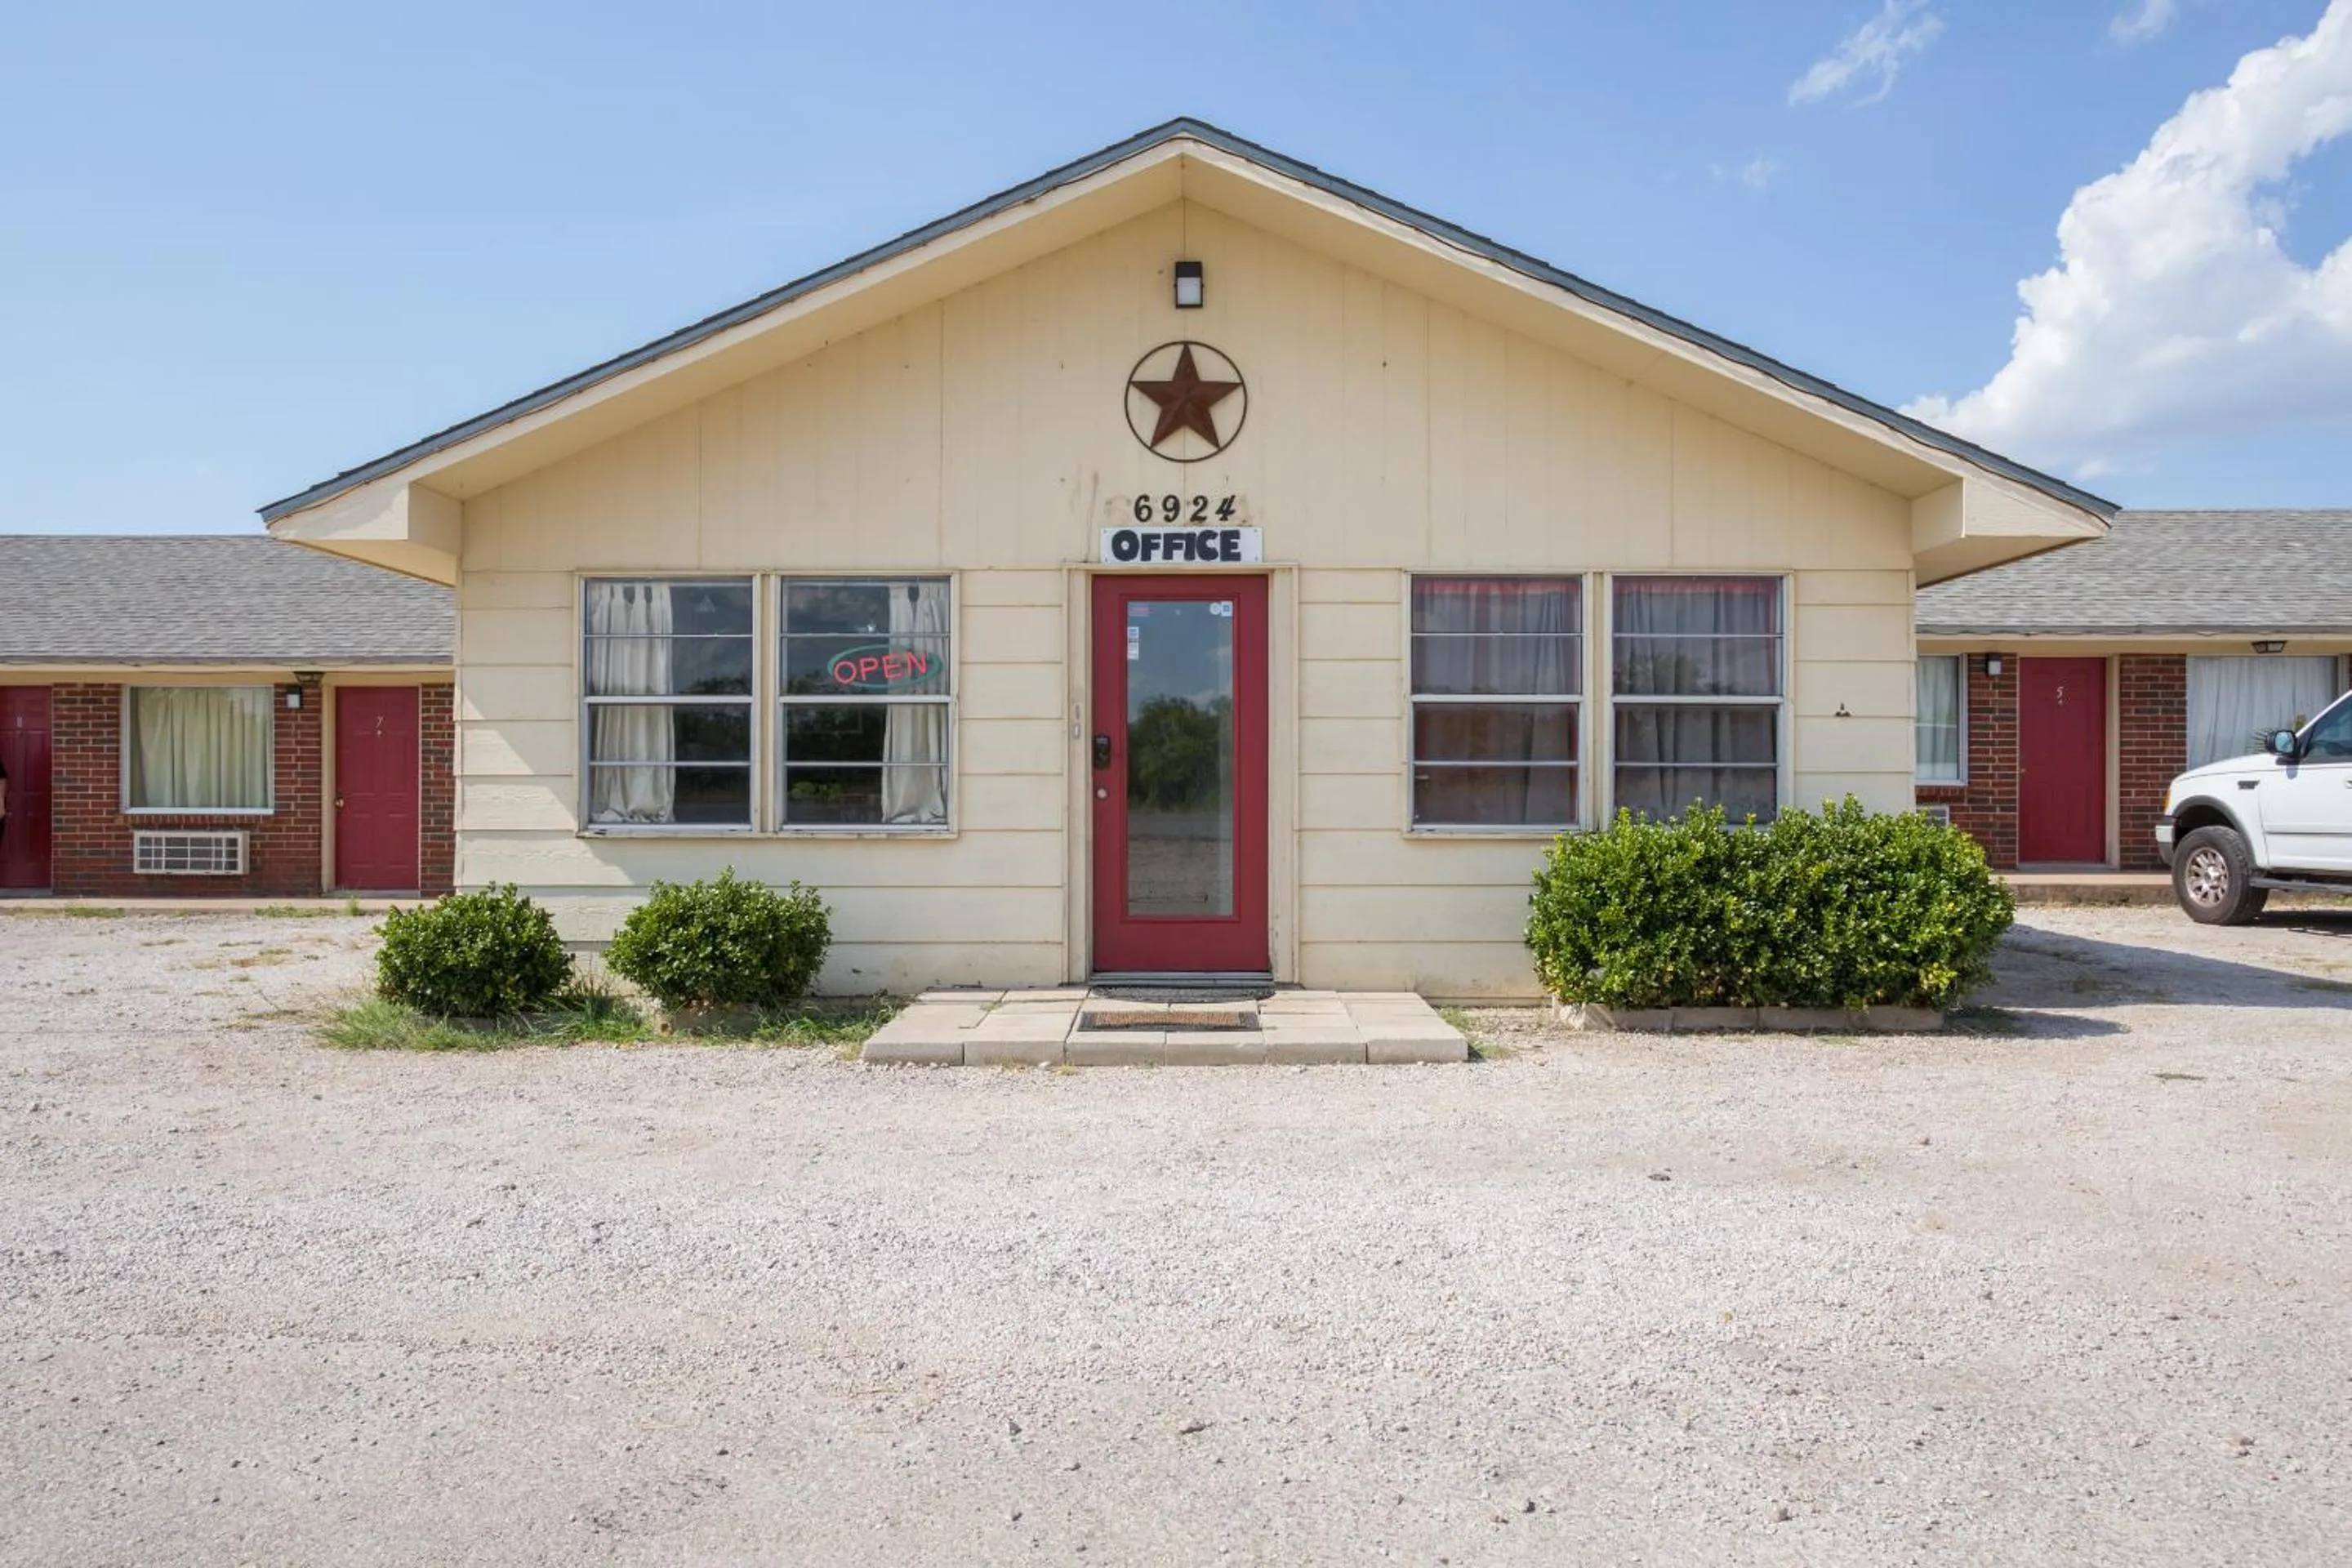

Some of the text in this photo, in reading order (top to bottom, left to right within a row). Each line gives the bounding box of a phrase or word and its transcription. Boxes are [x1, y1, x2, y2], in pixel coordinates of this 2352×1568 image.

[1134, 493, 1236, 523] 6924
[1111, 529, 1241, 562] OFFICE
[833, 651, 928, 684] OPEN
